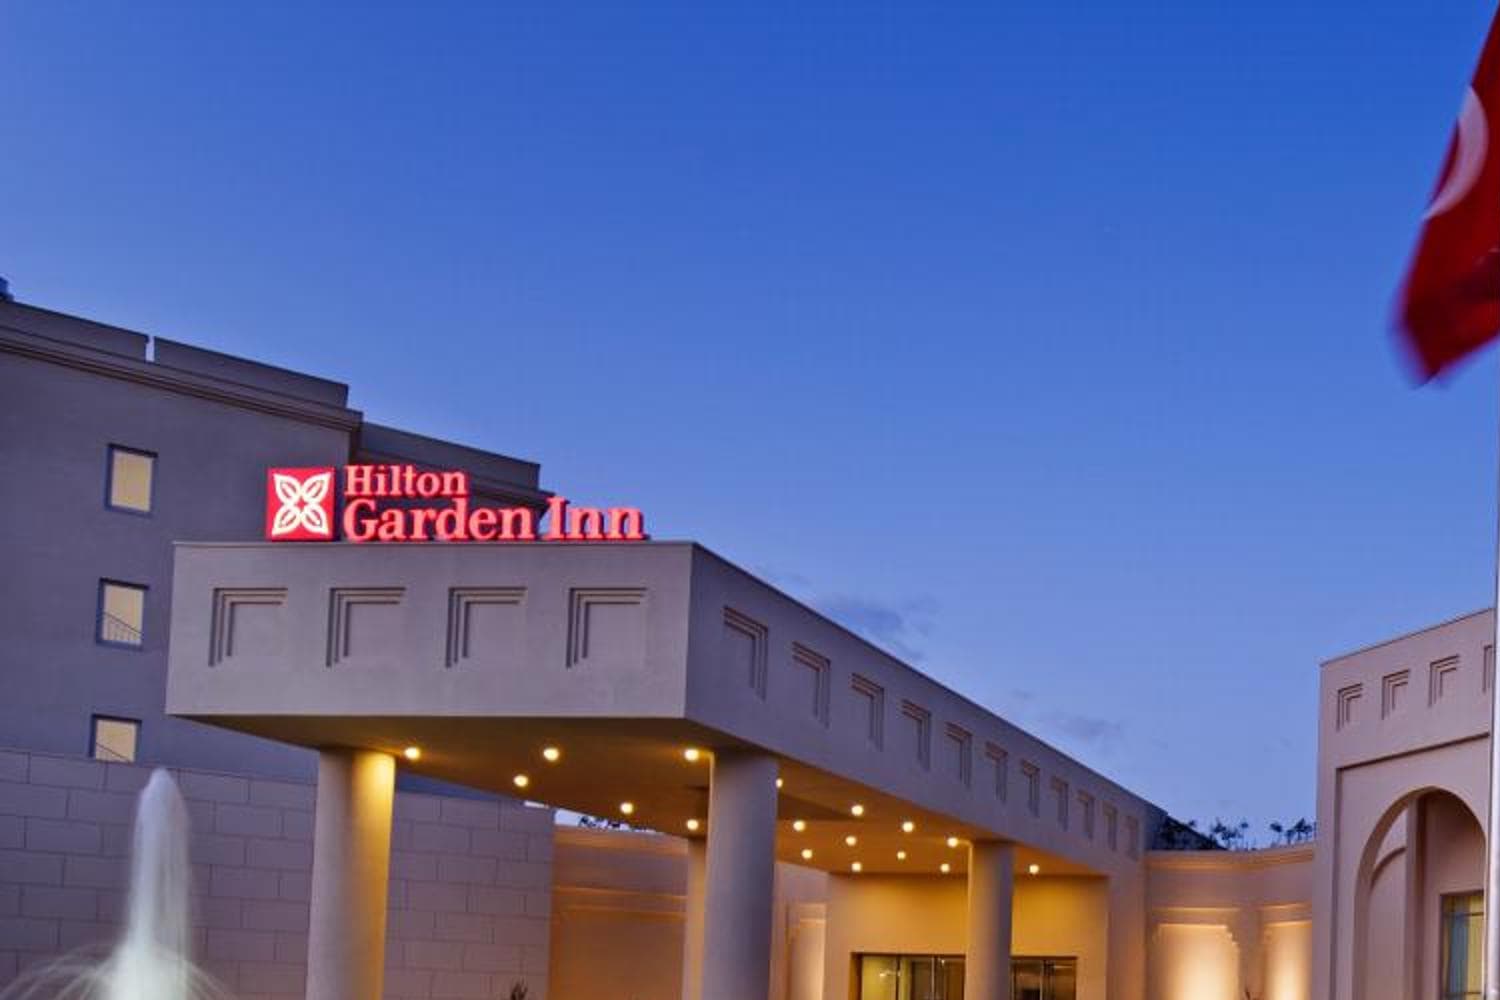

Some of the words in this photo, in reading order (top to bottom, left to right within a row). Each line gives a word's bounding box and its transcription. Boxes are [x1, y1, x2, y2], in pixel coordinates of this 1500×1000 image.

[343, 465, 468, 497] Hilton
[343, 499, 535, 541] Garden
[543, 496, 646, 540] Inn
